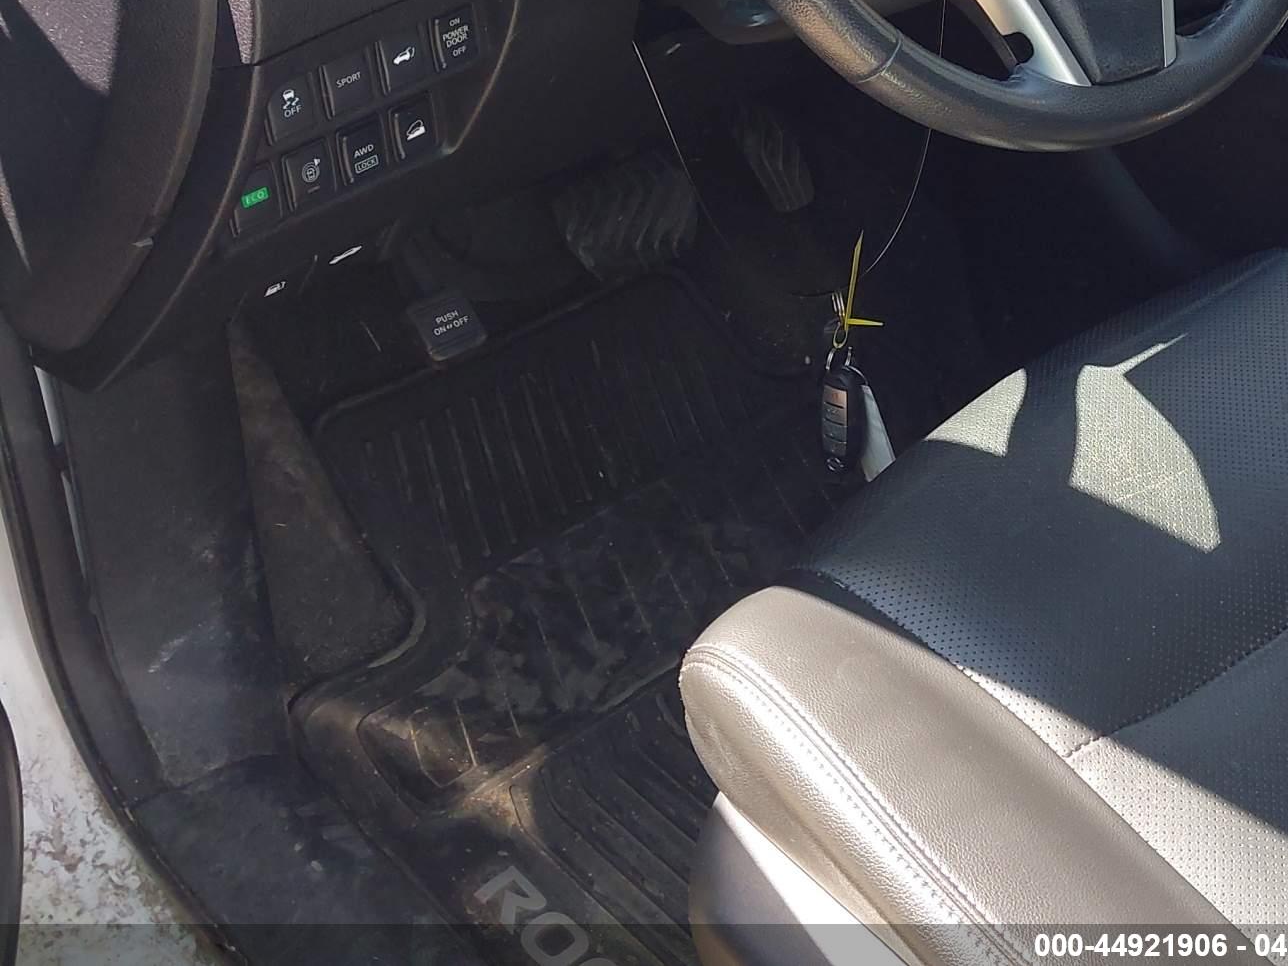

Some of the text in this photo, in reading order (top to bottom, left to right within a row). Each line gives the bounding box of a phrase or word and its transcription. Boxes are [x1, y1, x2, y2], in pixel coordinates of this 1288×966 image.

[449, 17, 460, 27] ON
[442, 25, 469, 42] POWER
[446, 33, 467, 48] DOOR
[452, 45, 467, 57] OFF
[336, 71, 362, 89] SPORT
[284, 104, 302, 119] OFF
[354, 144, 375, 159] AWD
[357, 158, 377, 171] LOCK
[245, 191, 265, 205] ECO
[435, 309, 459, 324] PUSH
[433, 315, 469, 336] ON OFF
